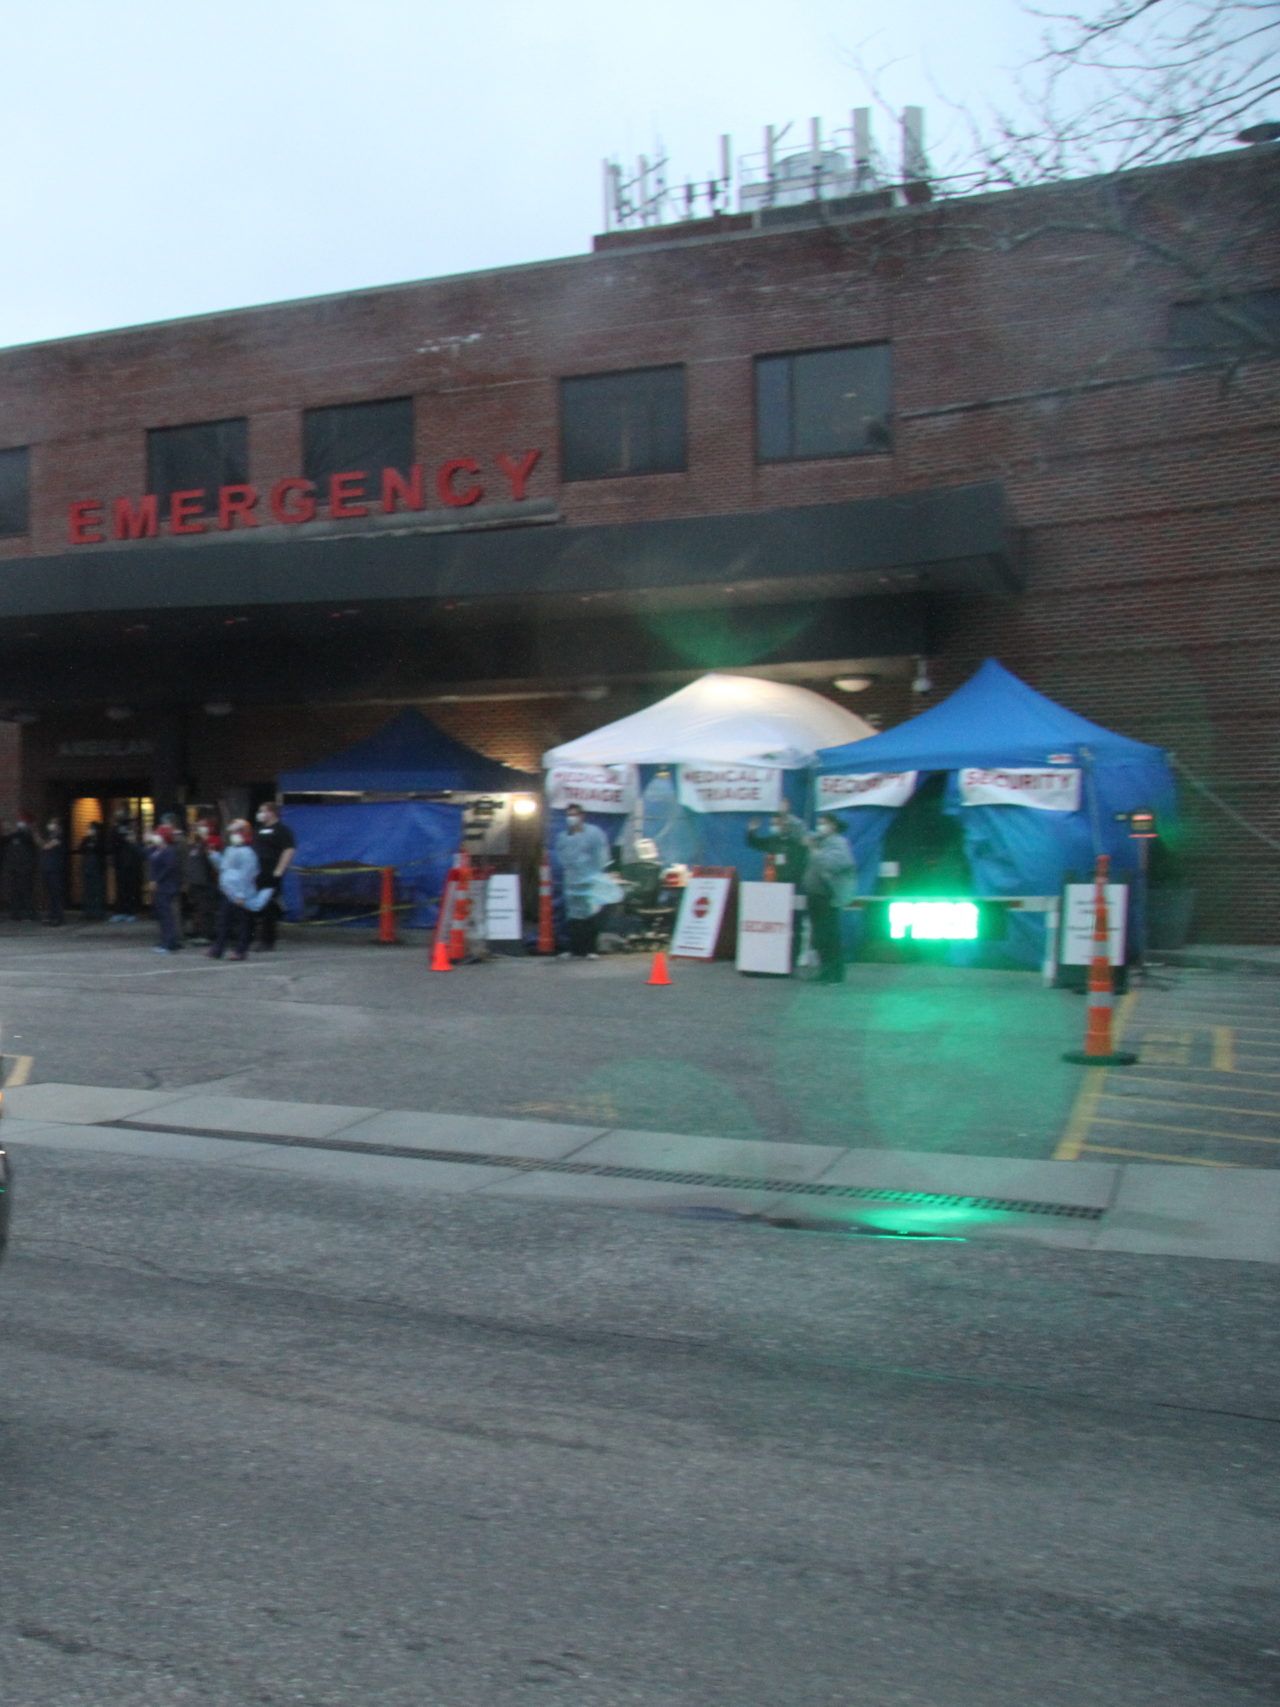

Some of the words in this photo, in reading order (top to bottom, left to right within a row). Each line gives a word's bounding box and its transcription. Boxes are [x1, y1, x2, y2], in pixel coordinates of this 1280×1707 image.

[69, 449, 541, 545] EMERGENCY
[683, 769, 761, 784] MEDICAL
[963, 769, 1072, 789] SECURITY
[562, 785, 624, 803] TRIAGE
[694, 787, 761, 801] TRIAGE
